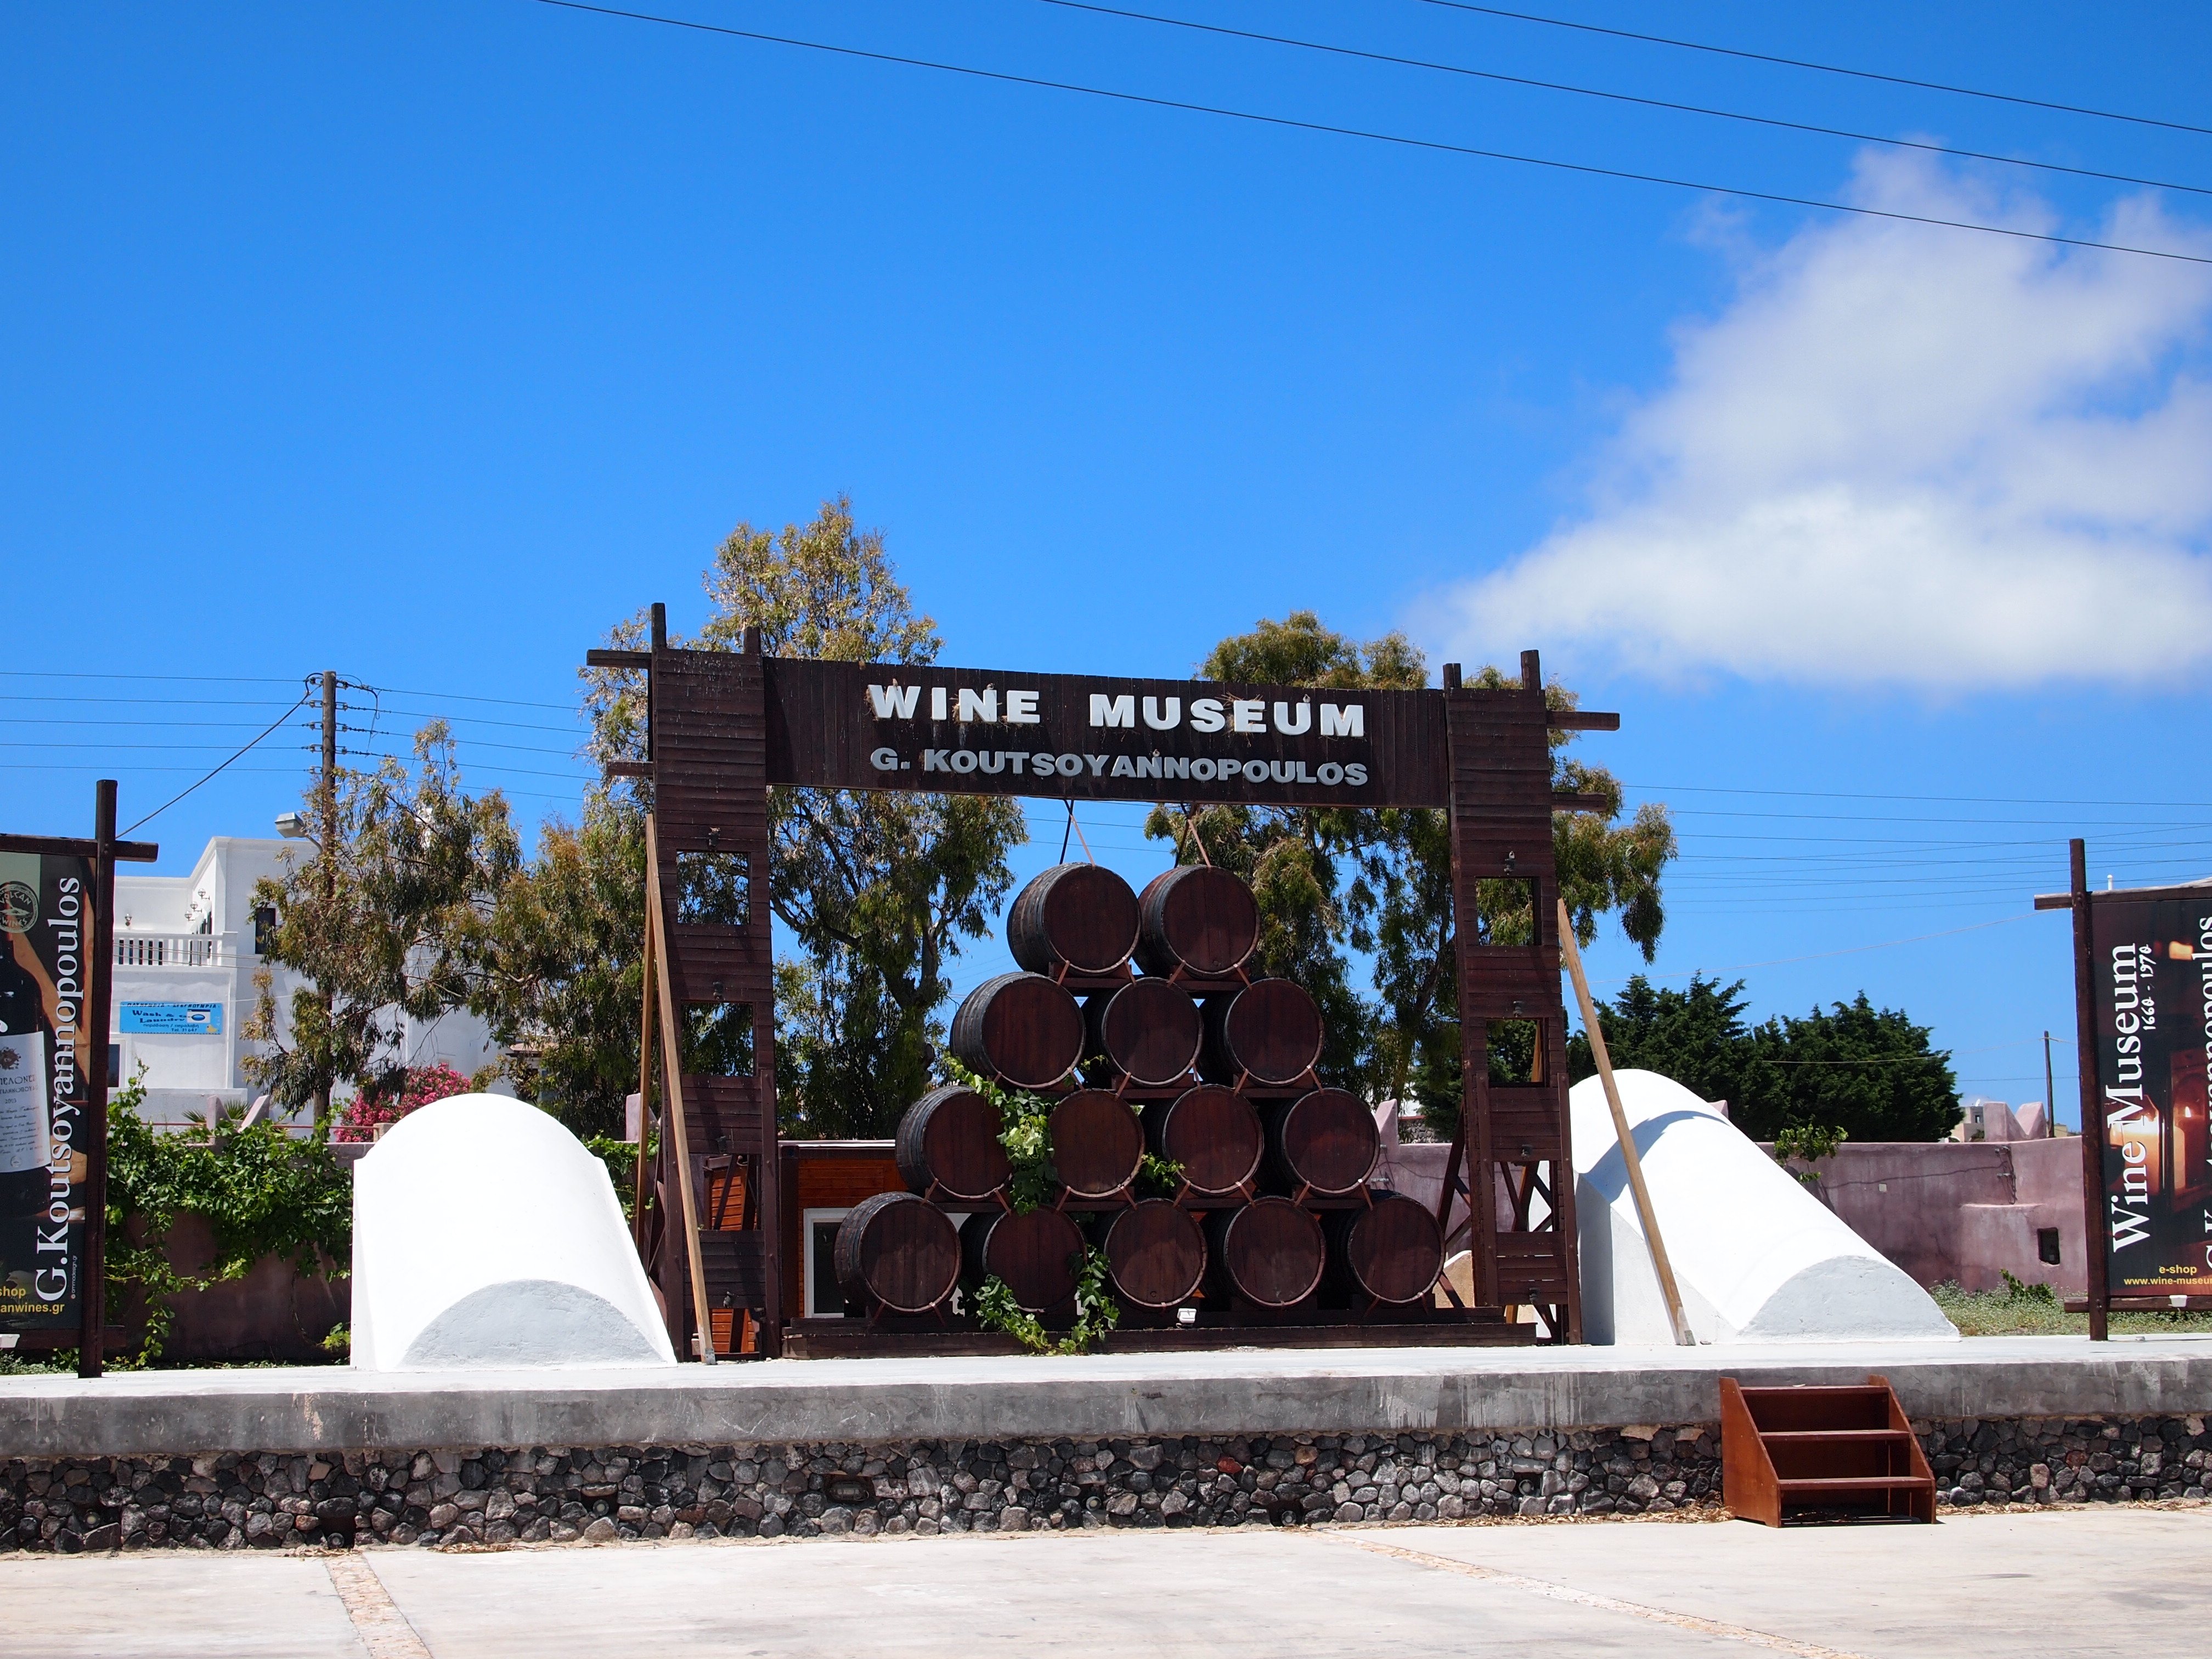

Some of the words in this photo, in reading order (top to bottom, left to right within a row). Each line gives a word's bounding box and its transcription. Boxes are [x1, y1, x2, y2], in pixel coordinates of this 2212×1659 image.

[867, 684, 1040, 724] WINE
[1089, 693, 1364, 737] MUSEUM
[870, 747, 911, 771] G.
[923, 748, 1368, 787] KOUTSOYANNOPOULOS
[2138, 944, 2157, 978] 1970
[2141, 996, 2157, 1030] 1660
[2106, 943, 2144, 1137] Museum
[35, 877, 84, 1302] G.Koutsoyannopoulos
[2111, 1141, 2151, 1254] Wine
[2124, 1276, 2212, 1285] www.wine-museu
[2159, 1265, 2198, 1276] e-shop
